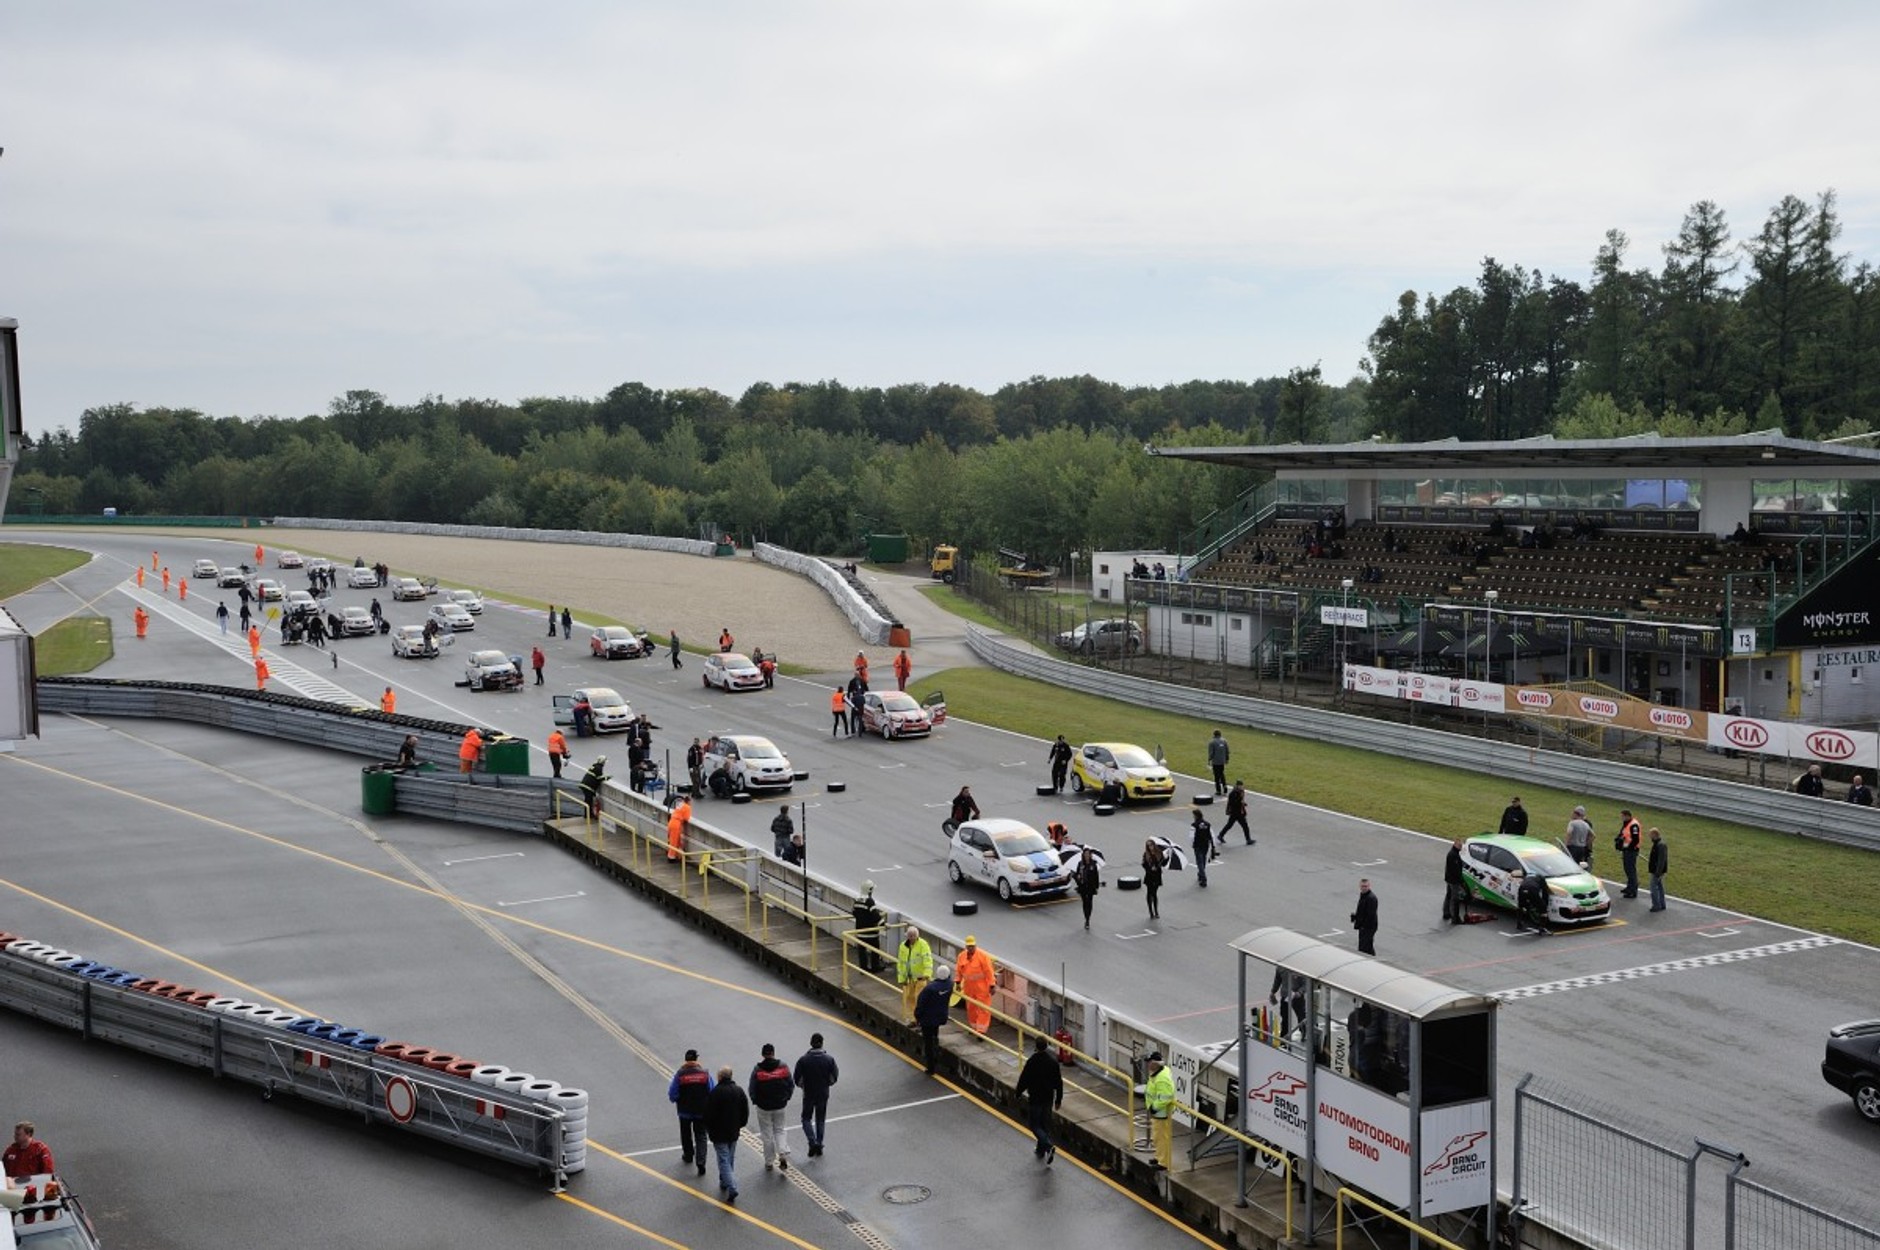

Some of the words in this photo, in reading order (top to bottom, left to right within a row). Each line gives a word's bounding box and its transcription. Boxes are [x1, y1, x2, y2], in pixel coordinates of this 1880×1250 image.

[1803, 611, 1870, 629] MONSTER
[1739, 634, 1750, 647] T3
[1528, 693, 1548, 705] LOTOS
[1592, 701, 1614, 714] LOTOS
[1663, 710, 1687, 726] LOTOS
[1733, 725, 1761, 744] KIA
[1814, 736, 1847, 755] KIA
[1172, 1051, 1195, 1075] LIGHTS
[1177, 1077, 1187, 1095] ON
[1274, 1095, 1299, 1116] BRNO
[1274, 1107, 1307, 1131] CIRCUIT
[1319, 1102, 1413, 1157] AUTOMOTODROM
[1348, 1136, 1380, 1162] BRNO
[1452, 1153, 1478, 1166] BRNO
[1452, 1161, 1486, 1175] CIRCUIT
